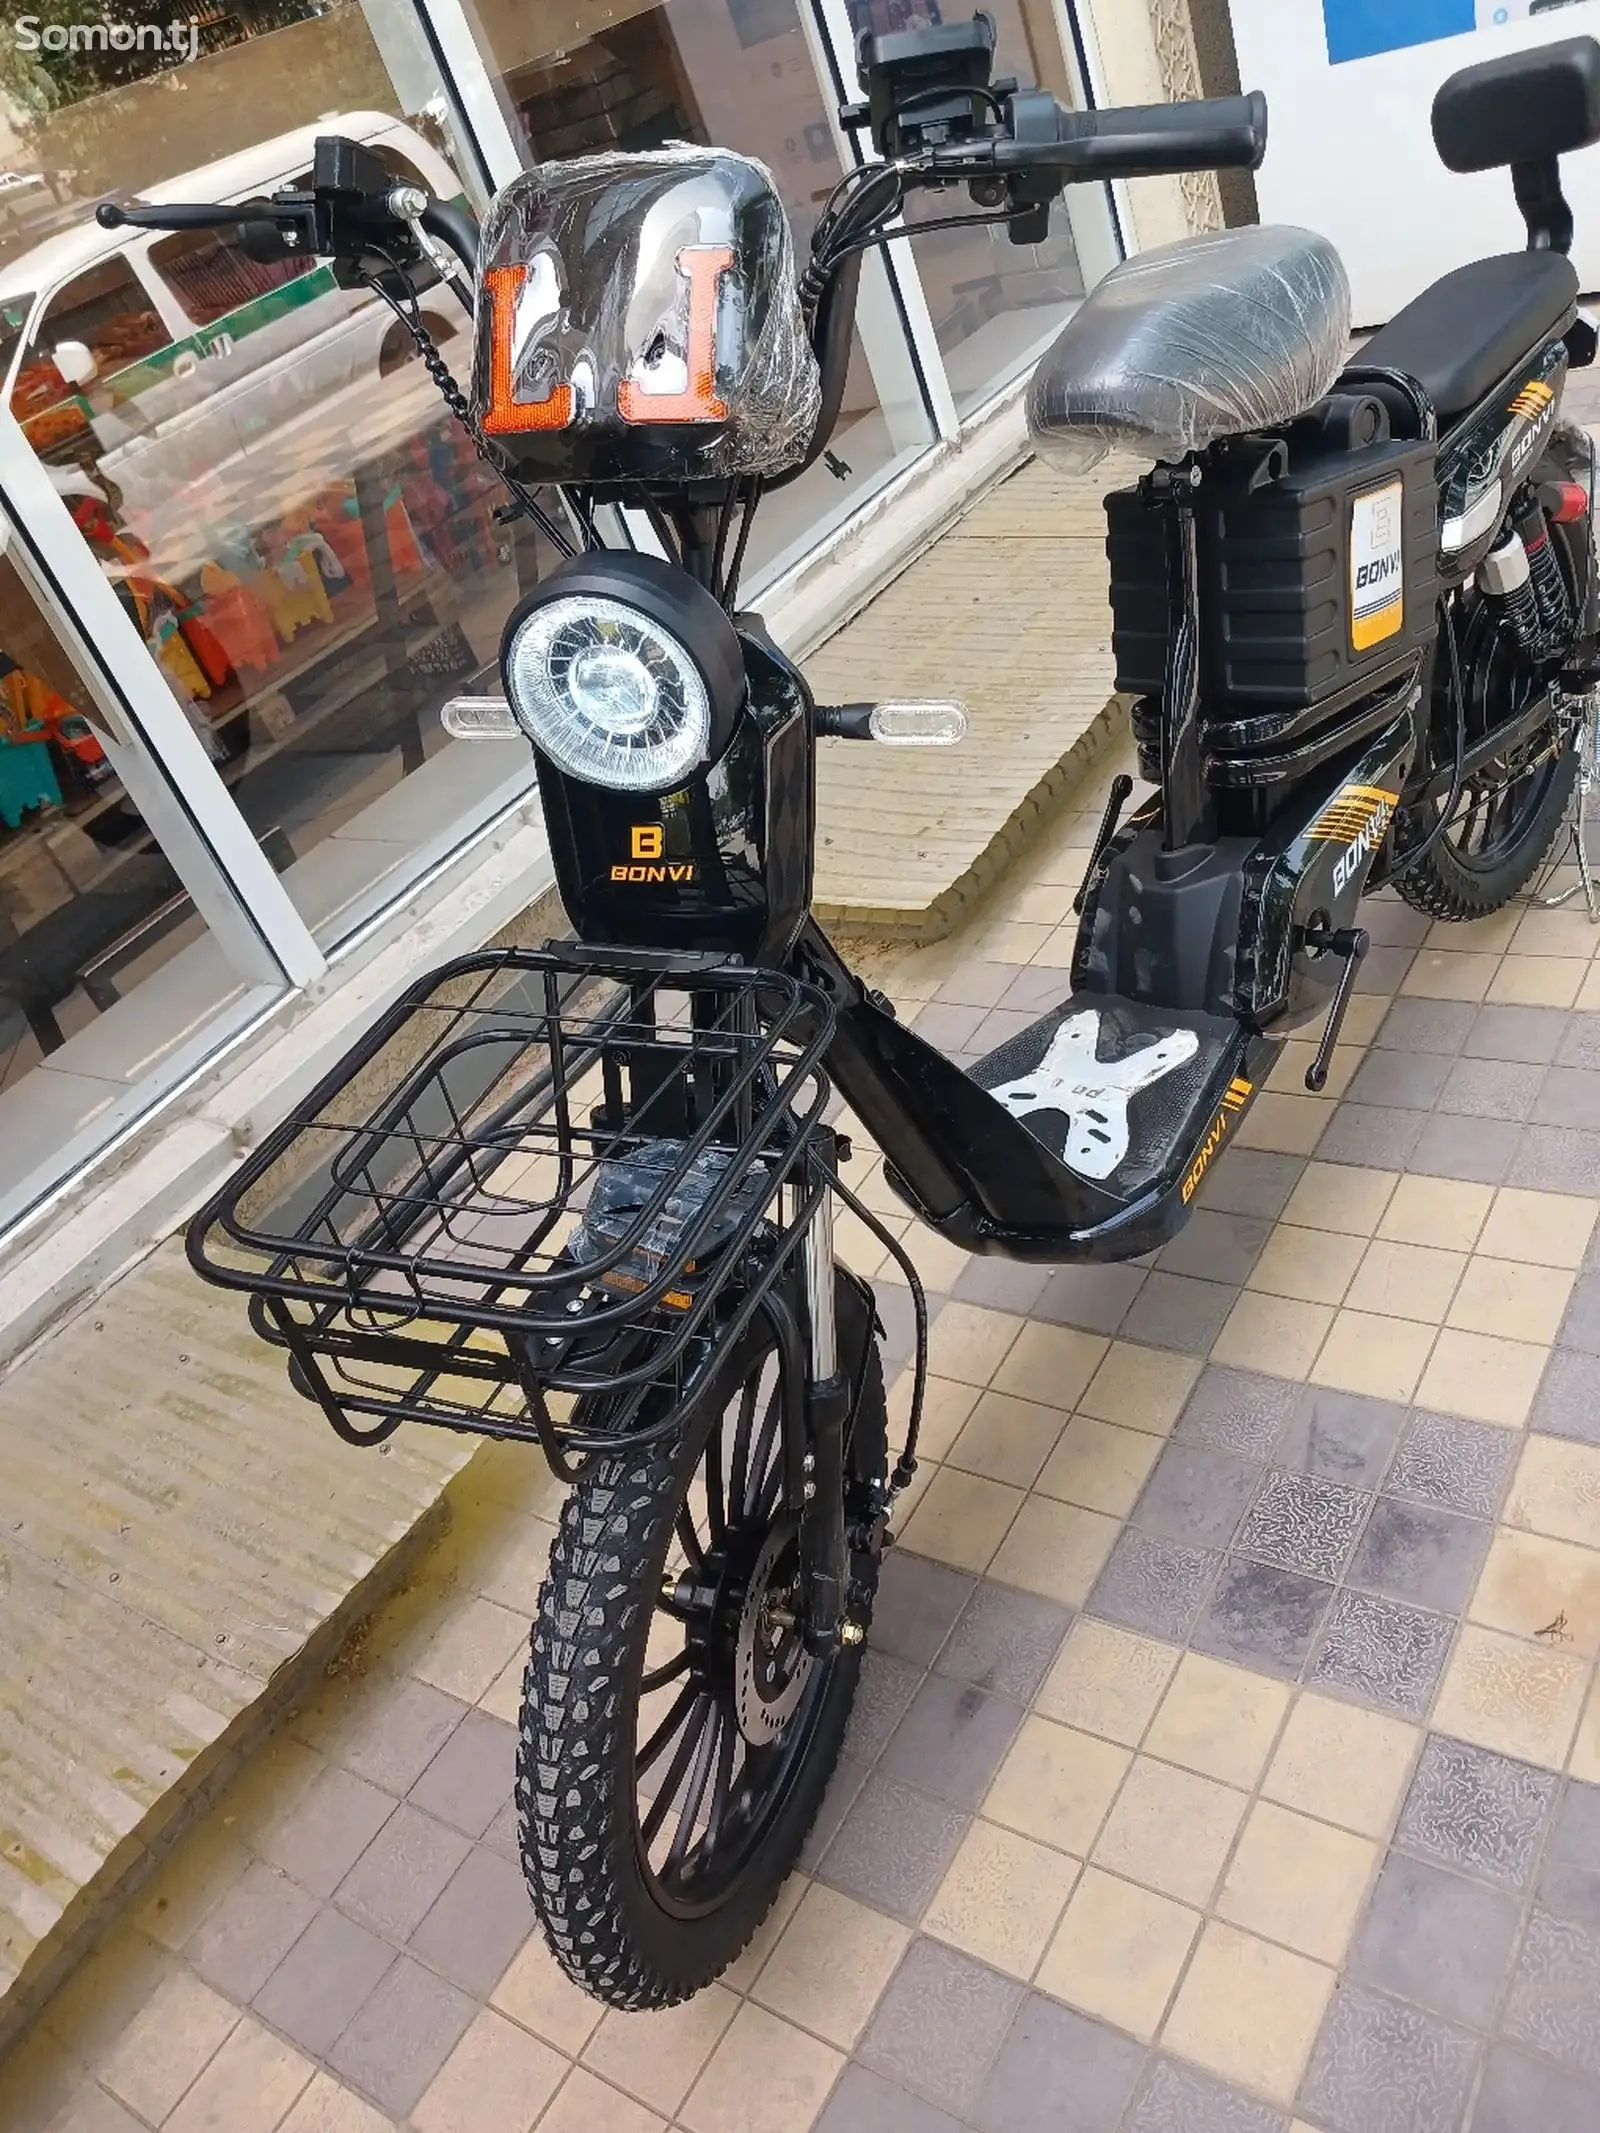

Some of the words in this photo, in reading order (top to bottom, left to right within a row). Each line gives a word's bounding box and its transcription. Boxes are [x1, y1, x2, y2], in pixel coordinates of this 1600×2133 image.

[1511, 396, 1555, 471] BONVI
[1356, 549, 1400, 590] BONVI
[631, 826, 663, 859] B
[1333, 798, 1389, 899] BONVI
[610, 865, 694, 882] BONVI
[1182, 1112, 1226, 1206] BONVI
